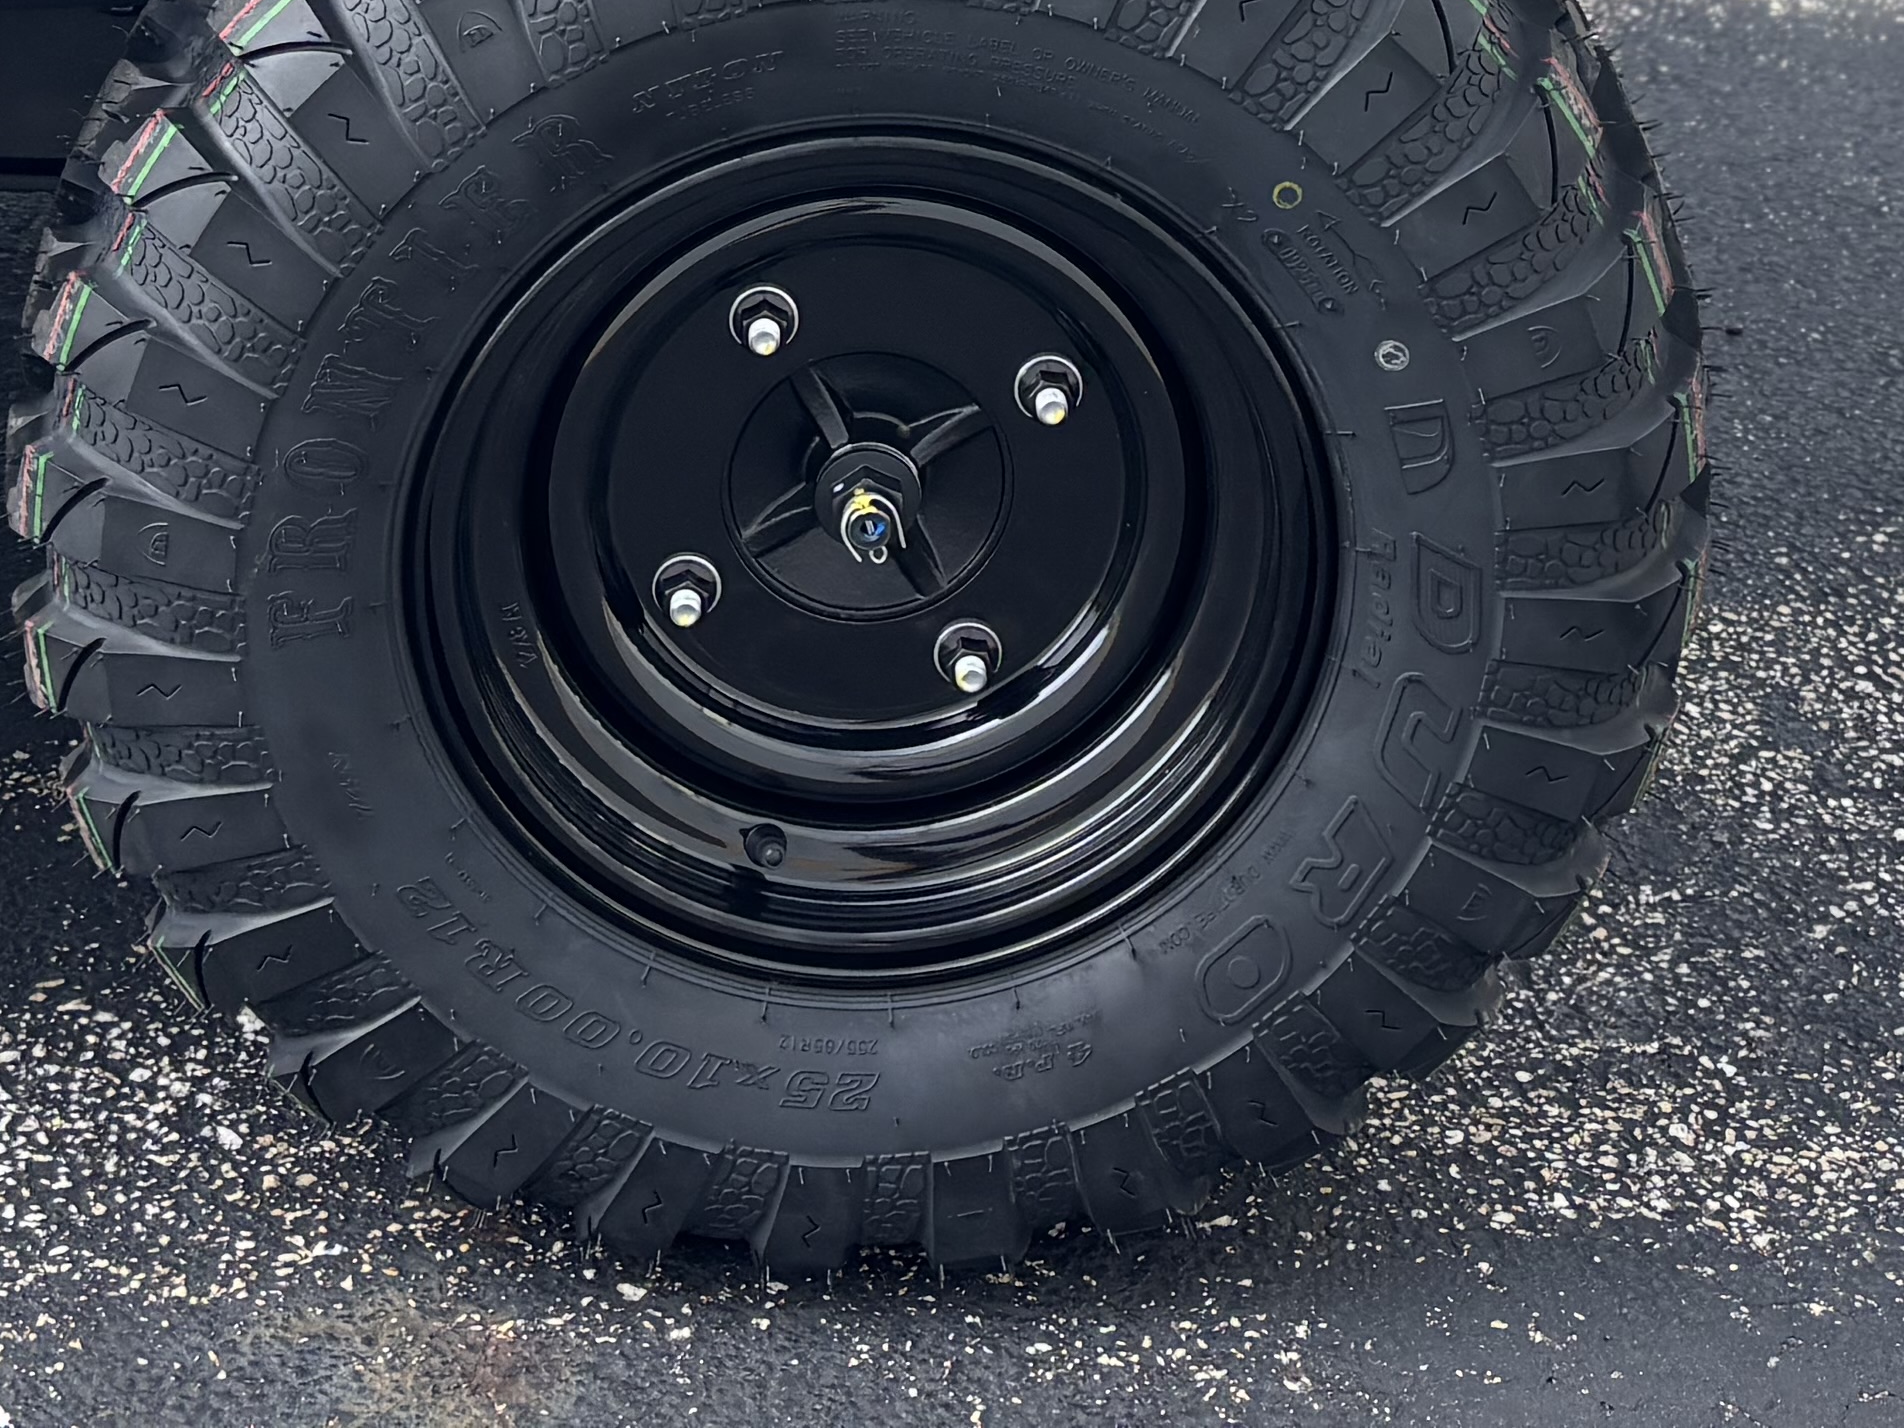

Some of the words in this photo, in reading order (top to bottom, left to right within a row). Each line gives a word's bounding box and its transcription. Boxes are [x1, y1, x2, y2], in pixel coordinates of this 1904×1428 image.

[966, 37, 1015, 55] LABEL
[1064, 56, 1137, 92] OWNER'S
[991, 55, 1077, 87] PRESSURE
[1296, 223, 1360, 295] ROTATION
[271, 112, 614, 644] FRONTIER
[1352, 529, 1400, 691] Radial
[1193, 530, 1484, 1026] DURO
[393, 871, 881, 1119] 25x10.00R12
[1066, 1041, 1093, 1068] 4
